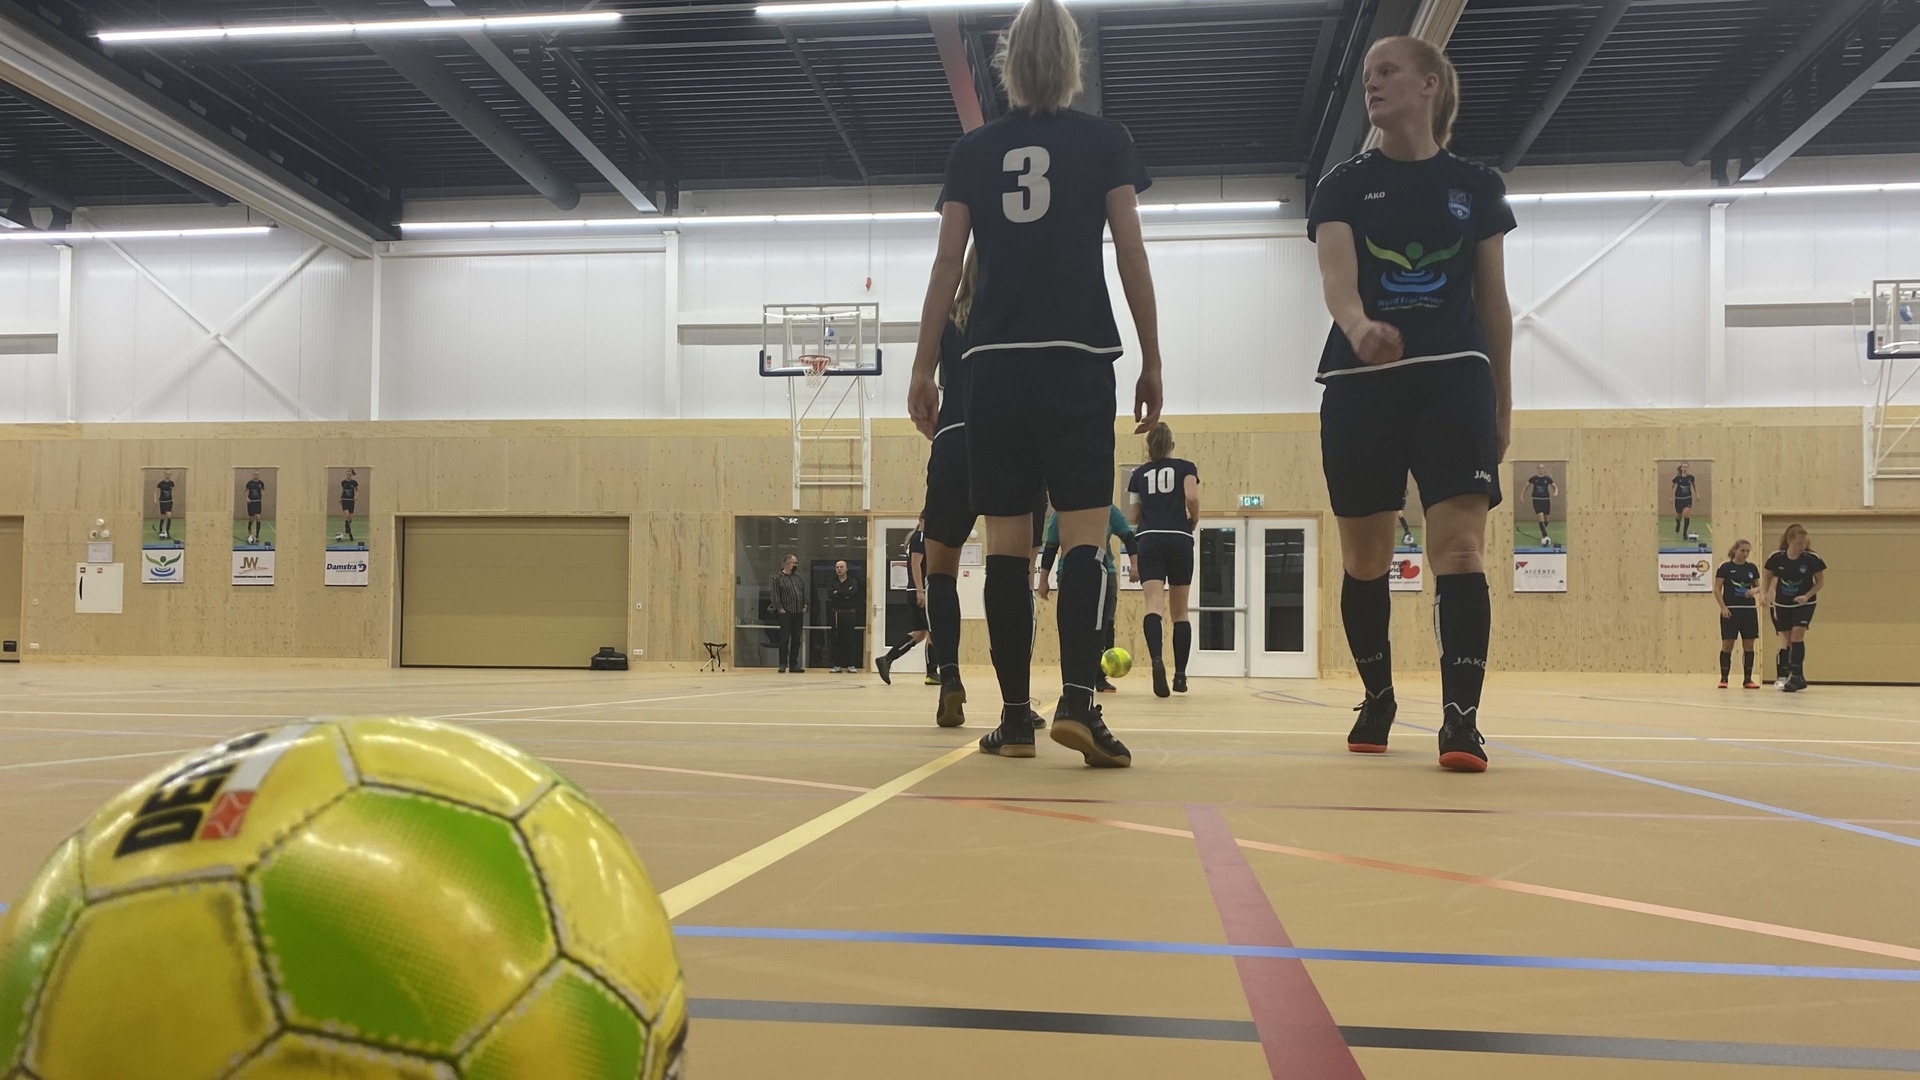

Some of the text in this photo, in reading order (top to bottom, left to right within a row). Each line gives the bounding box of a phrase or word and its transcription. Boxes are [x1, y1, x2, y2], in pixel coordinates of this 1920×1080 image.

[1002, 145, 1051, 224] 3
[1364, 191, 1386, 200] JAKO
[1143, 466, 1175, 495] 10
[240, 556, 259, 569] JW
